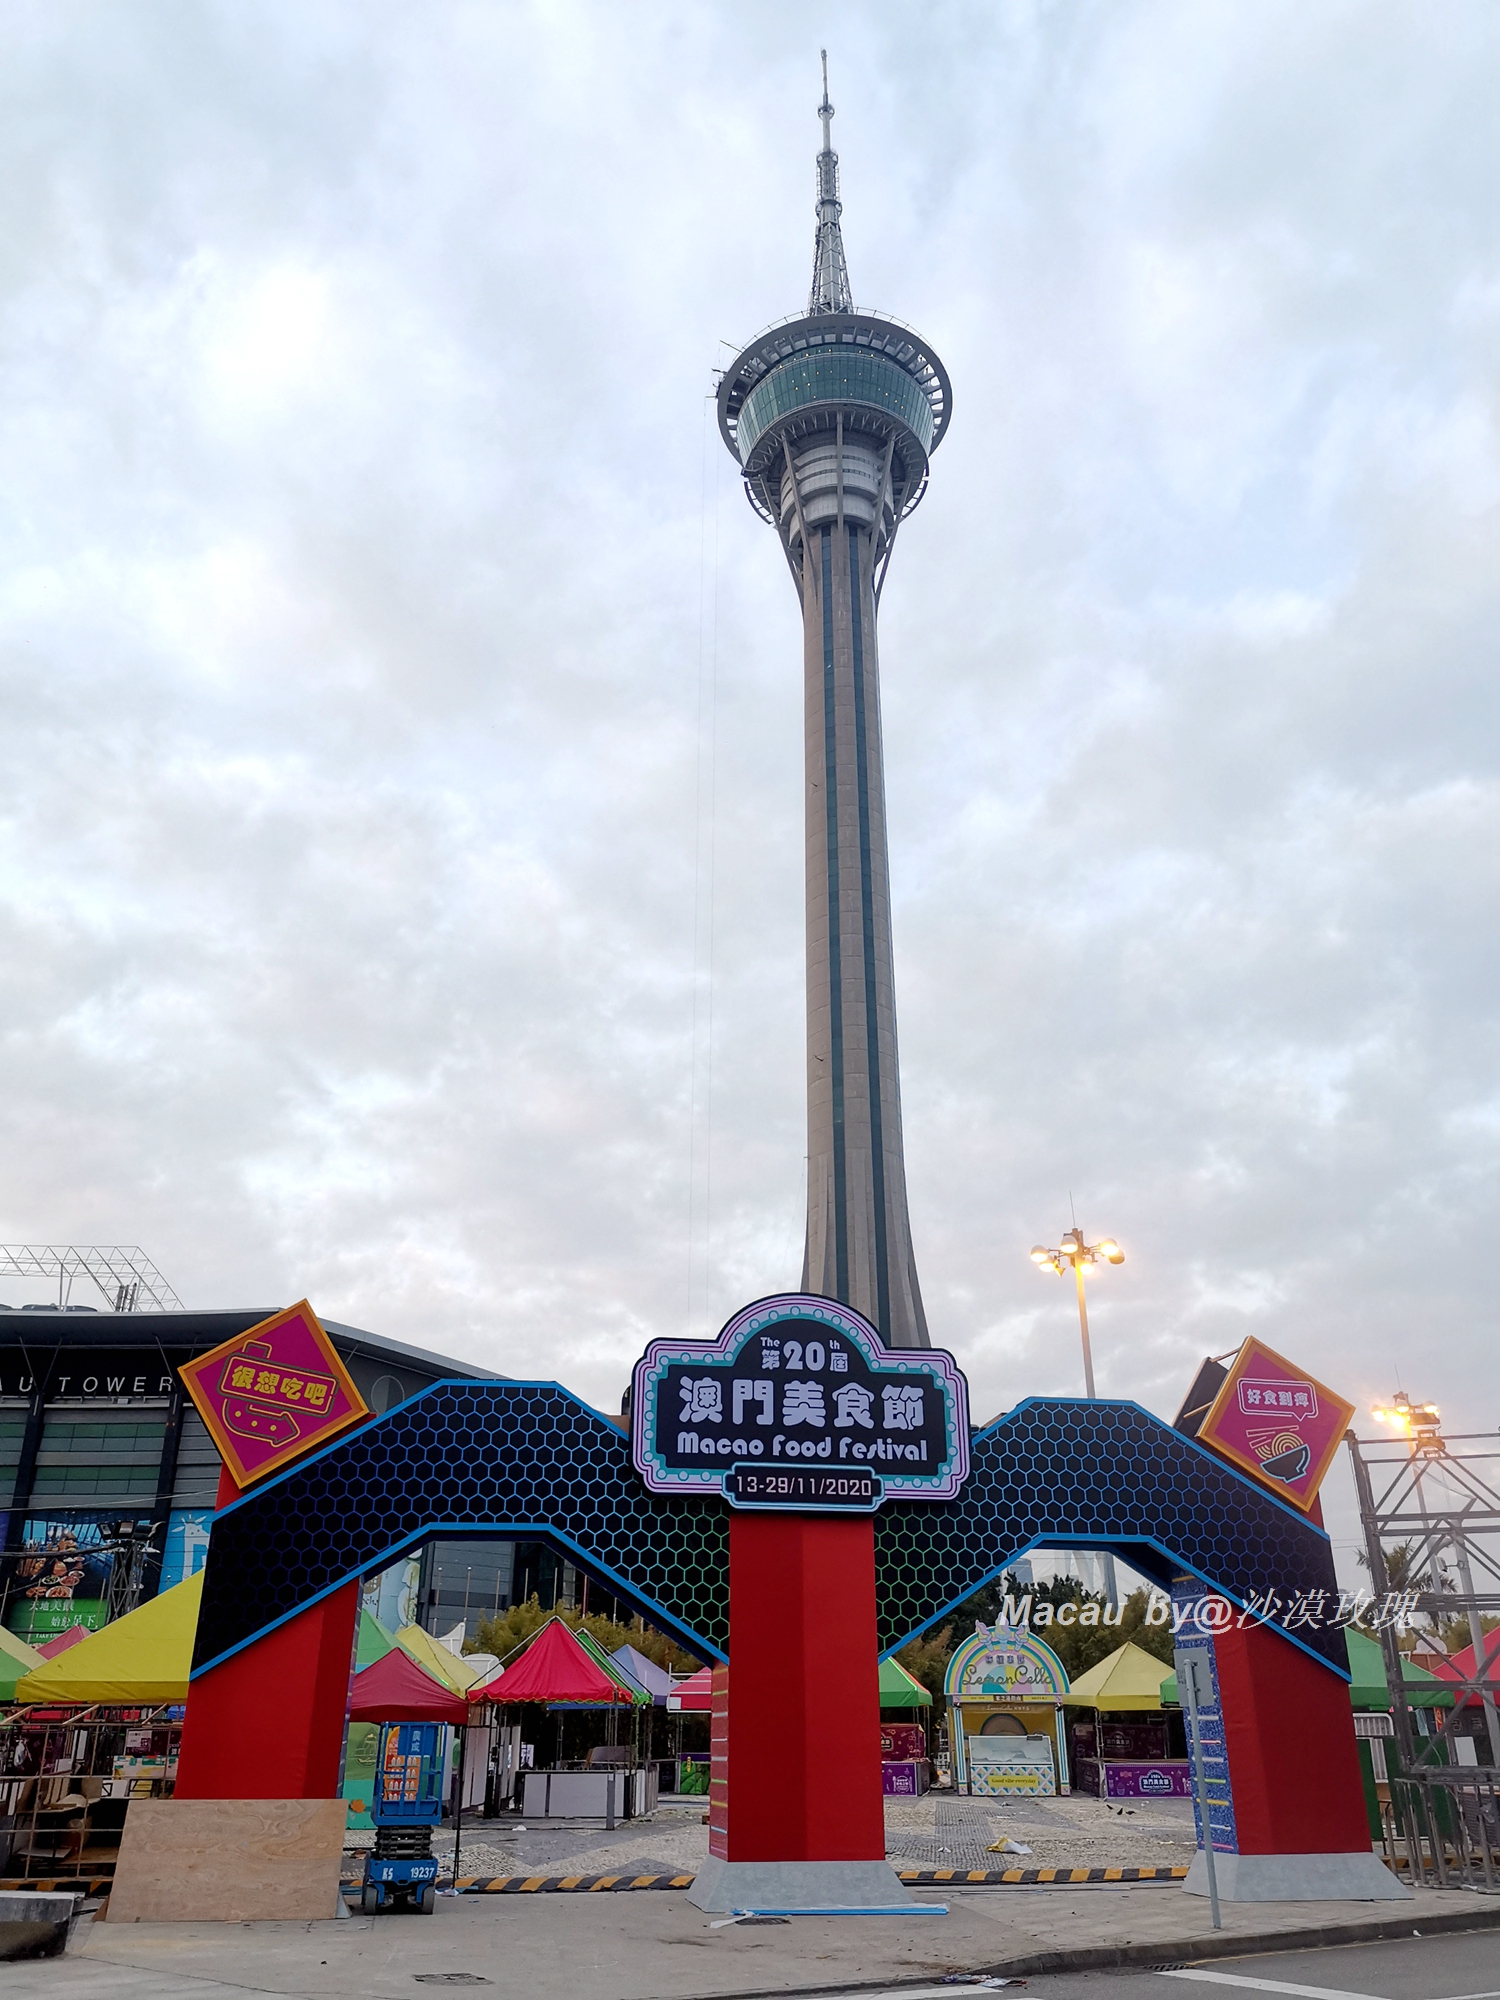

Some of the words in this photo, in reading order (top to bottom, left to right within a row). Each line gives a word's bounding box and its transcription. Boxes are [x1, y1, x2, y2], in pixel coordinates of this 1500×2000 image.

[760, 1336, 780, 1347] The
[829, 1339, 840, 1350] th
[58, 1376, 173, 1393] TOWER
[232, 1365, 328, 1406] 很想吃吧
[678, 1375, 925, 1431] 澳門美食節
[677, 1431, 764, 1457] Macao
[772, 1434, 832, 1459] Food
[839, 1437, 928, 1461] Festival
[736, 1475, 872, 1497] 13-29/11/2020
[410, 1866, 435, 1879] 19237
